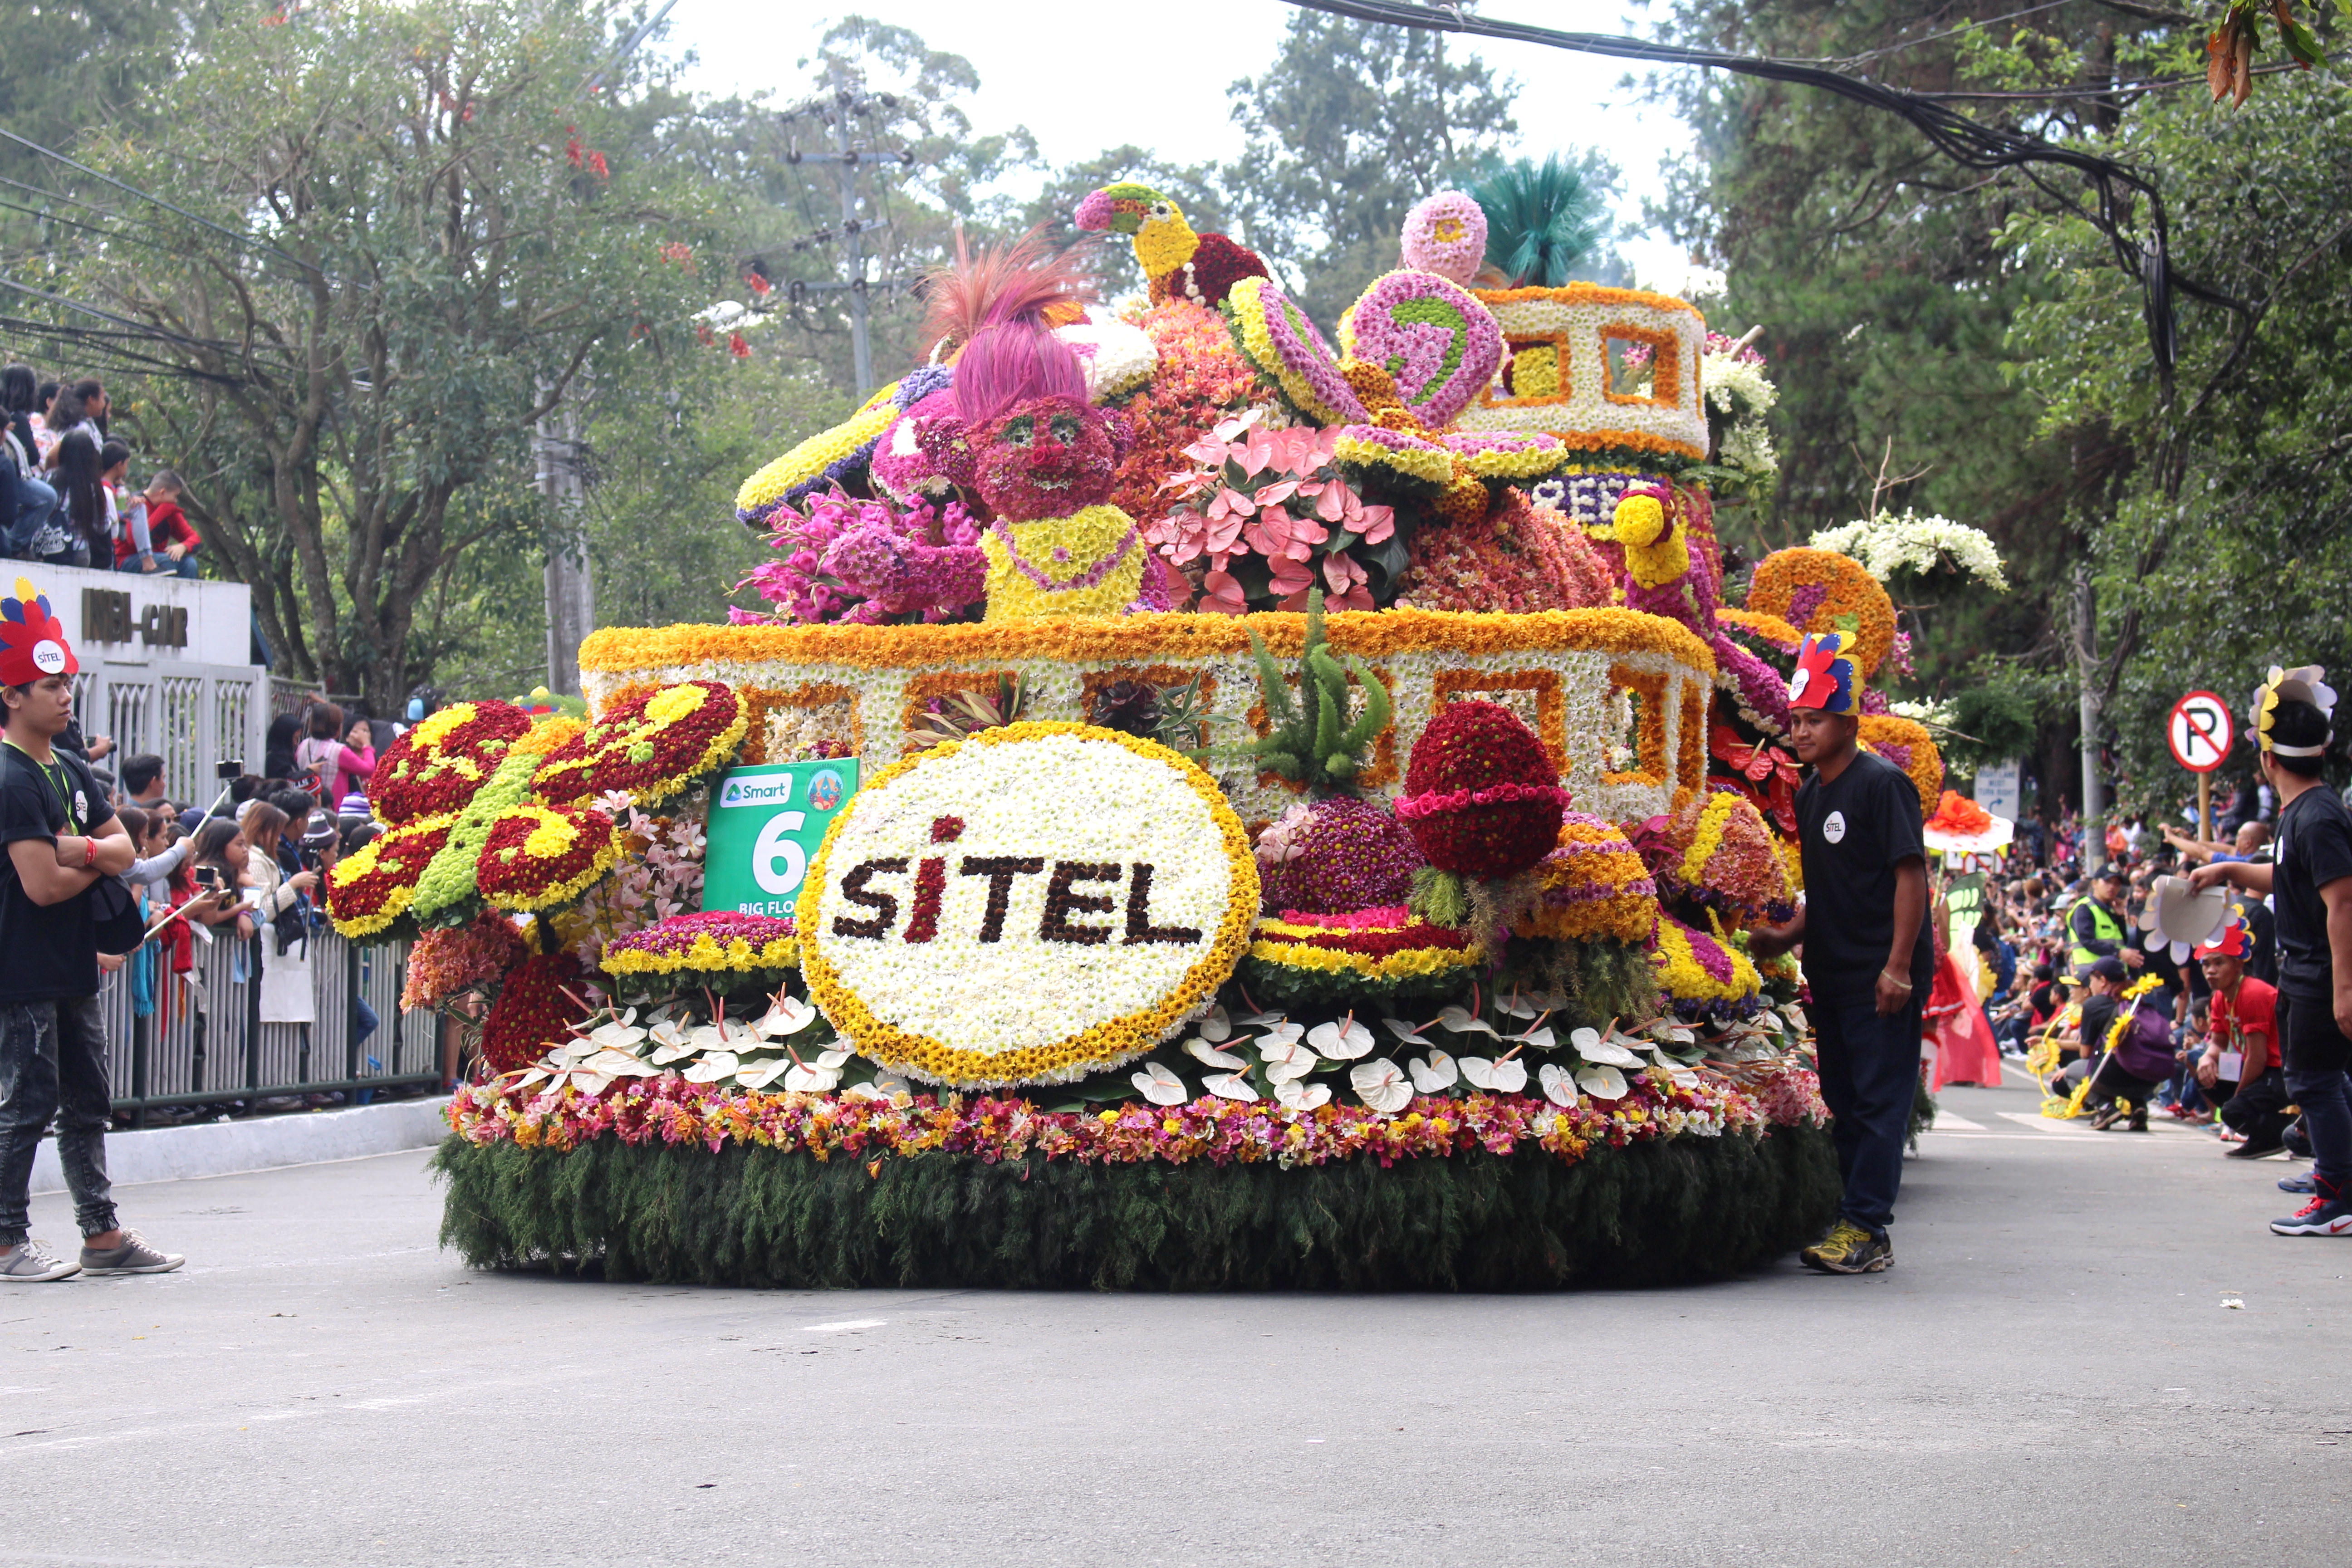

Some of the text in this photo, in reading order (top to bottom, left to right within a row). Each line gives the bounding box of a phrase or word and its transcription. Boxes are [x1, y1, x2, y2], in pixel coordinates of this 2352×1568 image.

[82, 587, 188, 647] NBI-CAR
[38, 651, 61, 663] SiTEL
[2187, 707, 2217, 756] P
[743, 783, 785, 799] Smart
[1826, 820, 1842, 832] SiTEL
[752, 811, 806, 895] 6
[832, 815, 1203, 946] SiTEL
[739, 900, 795, 915] BIG FLO
